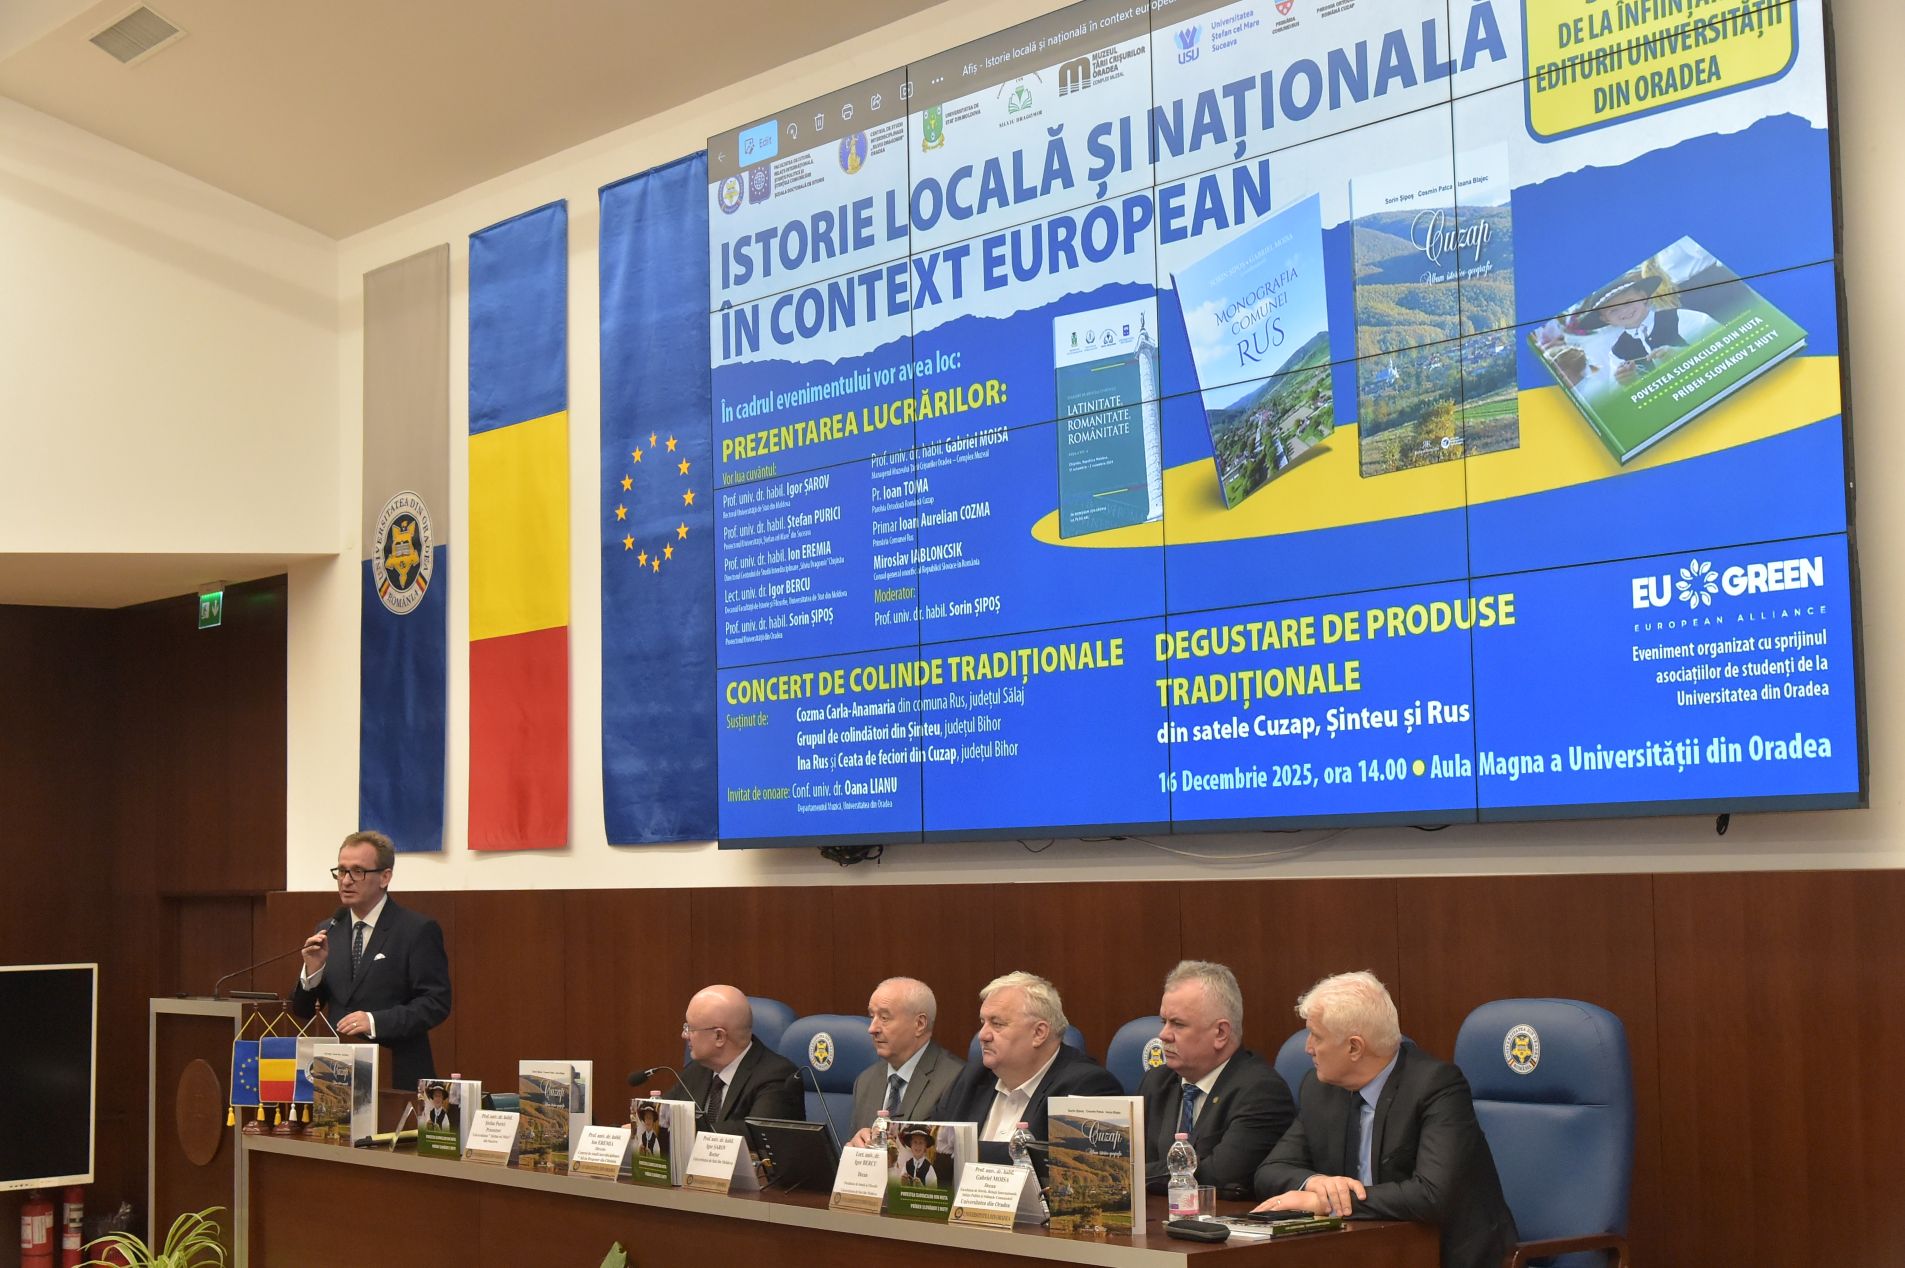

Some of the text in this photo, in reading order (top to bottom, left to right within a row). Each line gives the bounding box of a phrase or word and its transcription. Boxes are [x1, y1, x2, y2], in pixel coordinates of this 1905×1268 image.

[1211, 10, 1254, 30] Universitatea
[1212, 28, 1233, 42] Ștefan
[1233, 25, 1243, 37] cel
[1244, 20, 1260, 32] Mare
[1558, 9, 1613, 49] DE LA
[962, 10, 1133, 77] Afiș Istorie locală și națională în context
[1092, 47, 1118, 61] MUZEUL
[1109, 46, 1146, 65] CRIȘURILOR
[1178, 48, 1200, 65] USU
[1212, 39, 1238, 53] Suceava
[1536, 0, 1783, 93] EDITURII UNIVERSITĂȚII
[1092, 64, 1119, 79] ORADEA
[1594, 54, 1722, 114] DIN ORADEA
[758, 136, 773, 149] Edit
[721, 196, 875, 290] ISTORIE
[886, 123, 1075, 242] LOCALĂ
[1087, 116, 1133, 199] ȘI
[1385, 197, 1399, 205] Sorin
[1418, 188, 1438, 197] Cosmin
[1438, 184, 1453, 193] Patca
[1473, 176, 1489, 186] Blajec
[1411, 209, 1493, 267] Cuzap
[721, 301, 760, 361] ÎN
[770, 240, 971, 339] CONTEXT
[982, 158, 1272, 292] EUROPEAN
[1214, 267, 1298, 326] MONOGRAFIA
[1231, 292, 1288, 336] COMUNEI
[1237, 316, 1285, 368] RUS
[1631, 330, 1740, 404] POVESTEA SLOVACILOR DIN
[1672, 330, 1780, 402] PRÍBEH SLOVÁKOV Z HUTY
[722, 351, 961, 424] În cadrul evenimentului vor avea loc:
[1068, 395, 1123, 416] LATINITATE,
[1068, 408, 1132, 431] ROMANITATE,
[722, 379, 1008, 463] PREZENTAREA LUCRĂRILOR:
[1068, 422, 1130, 445] ROMÂNITATE
[946, 426, 1009, 454] Gabriel MOISA
[723, 465, 777, 486] Vor lua cuvântul:
[786, 474, 830, 499] Igor ȘAROV
[884, 478, 929, 500] Ioan TOMA
[788, 513, 813, 534] Ștefan
[814, 506, 841, 524] PURICI
[873, 502, 991, 536] Primar Ioan Aurelian COZMA
[788, 541, 832, 562] Ion EREMIA
[874, 552, 909, 570] Miroslav
[911, 542, 963, 564] IABLONCSIK
[786, 577, 811, 594] BERCU
[874, 587, 916, 604] Moderator:
[1632, 556, 1824, 609] EU GREEN
[790, 608, 834, 628] Sorin ȘIPOȘ
[949, 596, 1001, 618] Sorin ȘIPOȘ
[1634, 606, 1827, 633] EUROPEAN ALLIANCE
[1155, 593, 1516, 662] DEGUSTARE DE PRODUSE
[1632, 629, 1827, 662] Eveniment organizat sprijinul
[726, 638, 1124, 706] CONCERT DE COLINDE TRADIȚIONALE
[1156, 660, 1361, 709] TRADIȚIONALE
[1656, 656, 1813, 685] asociațiilor de studenți de
[796, 686, 1025, 722] Cozma Carla-Anamaria comuna Sălaj
[1677, 680, 1830, 706] Universitatea din Oradea
[726, 711, 769, 732] Susținut de:
[797, 715, 1002, 749] Grupul colindători Șinteu, Bihor
[1157, 700, 1471, 744] din satele Cuzap, Șinteu și Rus
[838, 740, 1019, 768] Ceata feciori Bihor
[1182, 732, 1832, 792] Decembrie 2025, ora 14.00 Aula Magna Universității din Oradea
[728, 777, 898, 802] Invitat onoare: Oana LIANU
